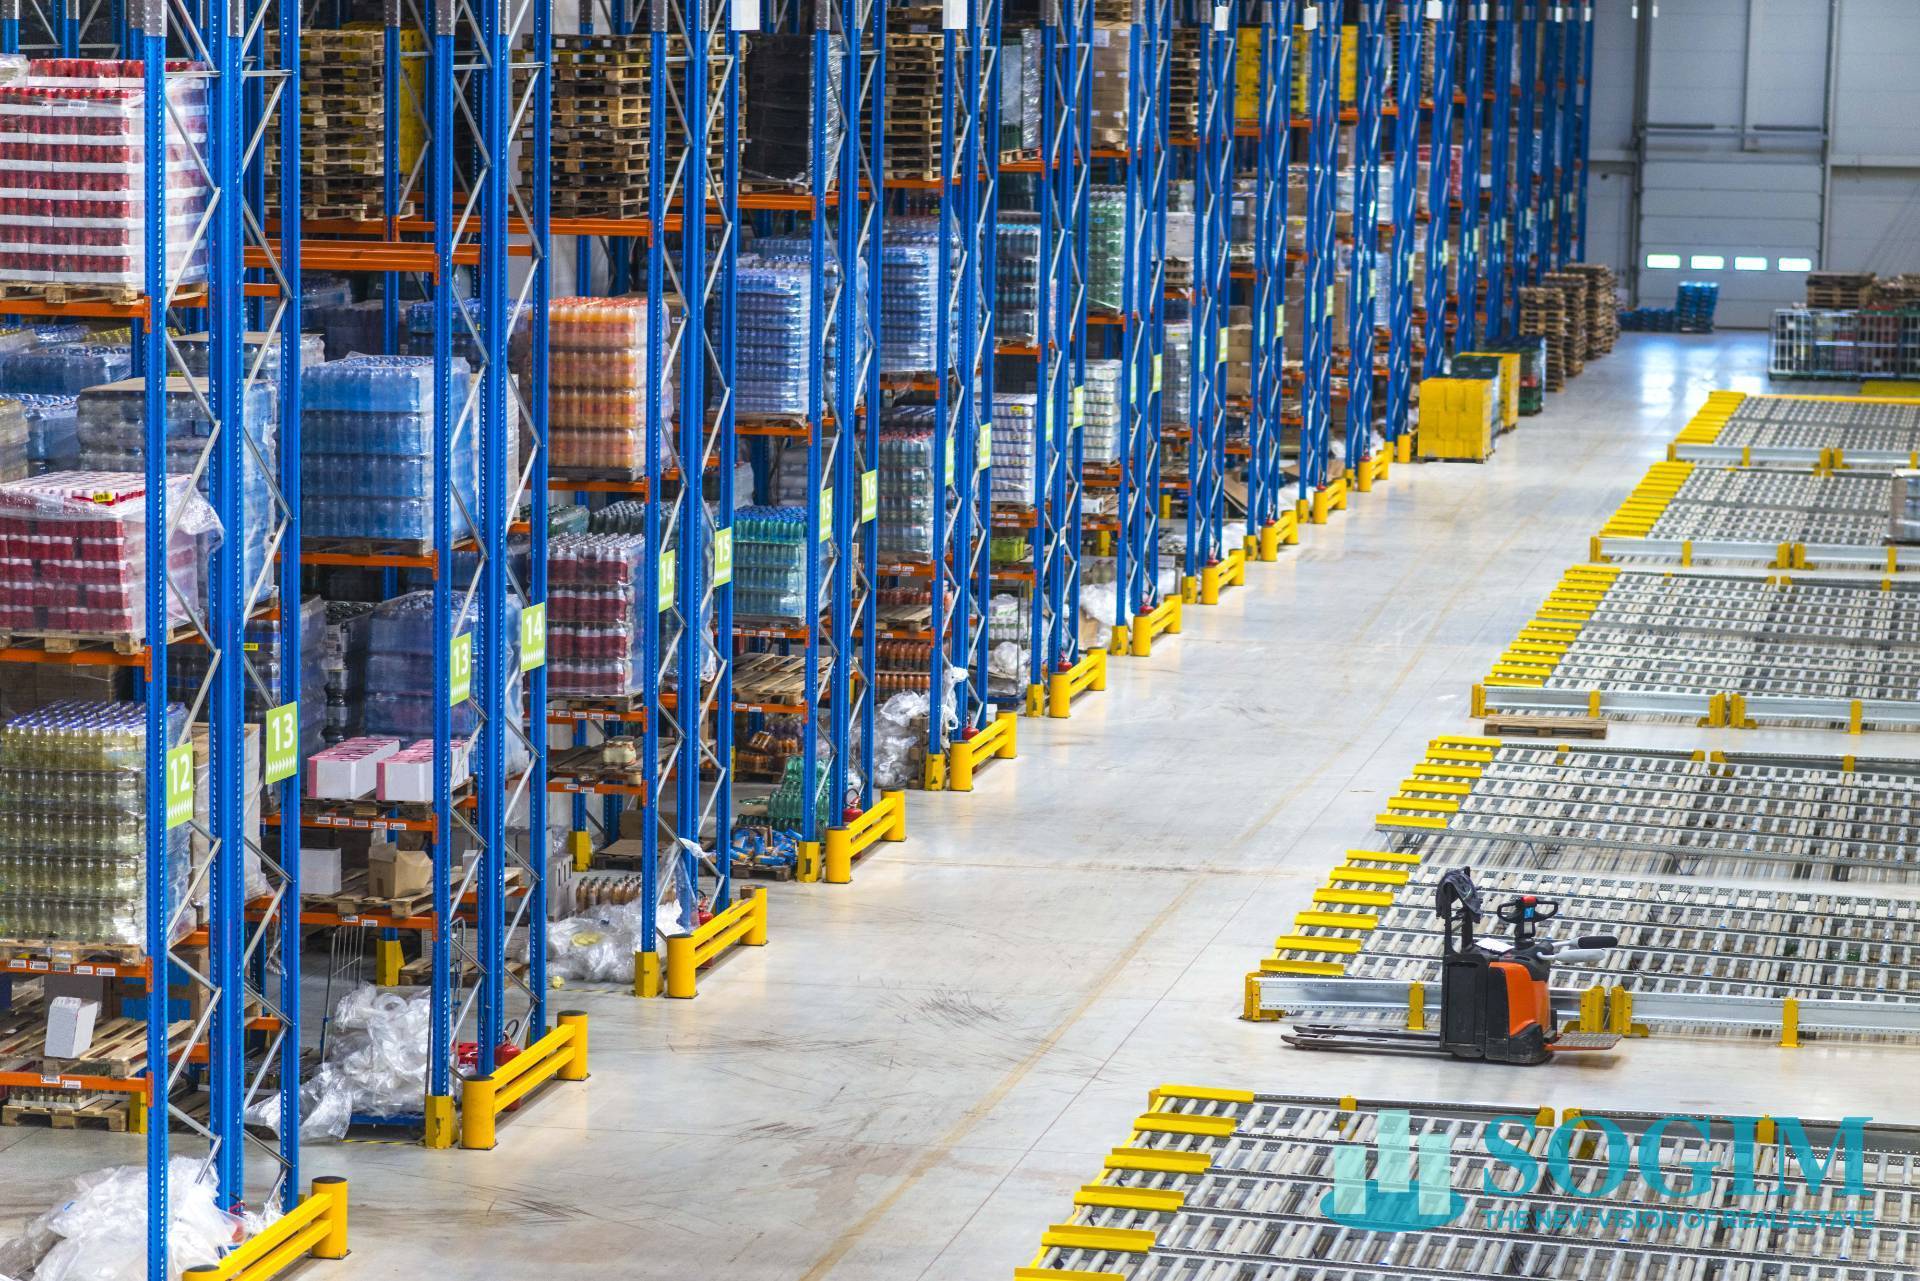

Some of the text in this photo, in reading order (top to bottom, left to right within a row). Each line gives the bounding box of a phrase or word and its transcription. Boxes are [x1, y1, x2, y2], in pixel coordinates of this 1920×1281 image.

[865, 476, 876, 501] 16
[718, 534, 731, 563] 15
[662, 557, 674, 588] 14
[525, 610, 544, 645] 14
[453, 641, 469, 678] 13
[272, 712, 294, 752] 13
[171, 753, 191, 796] 12
